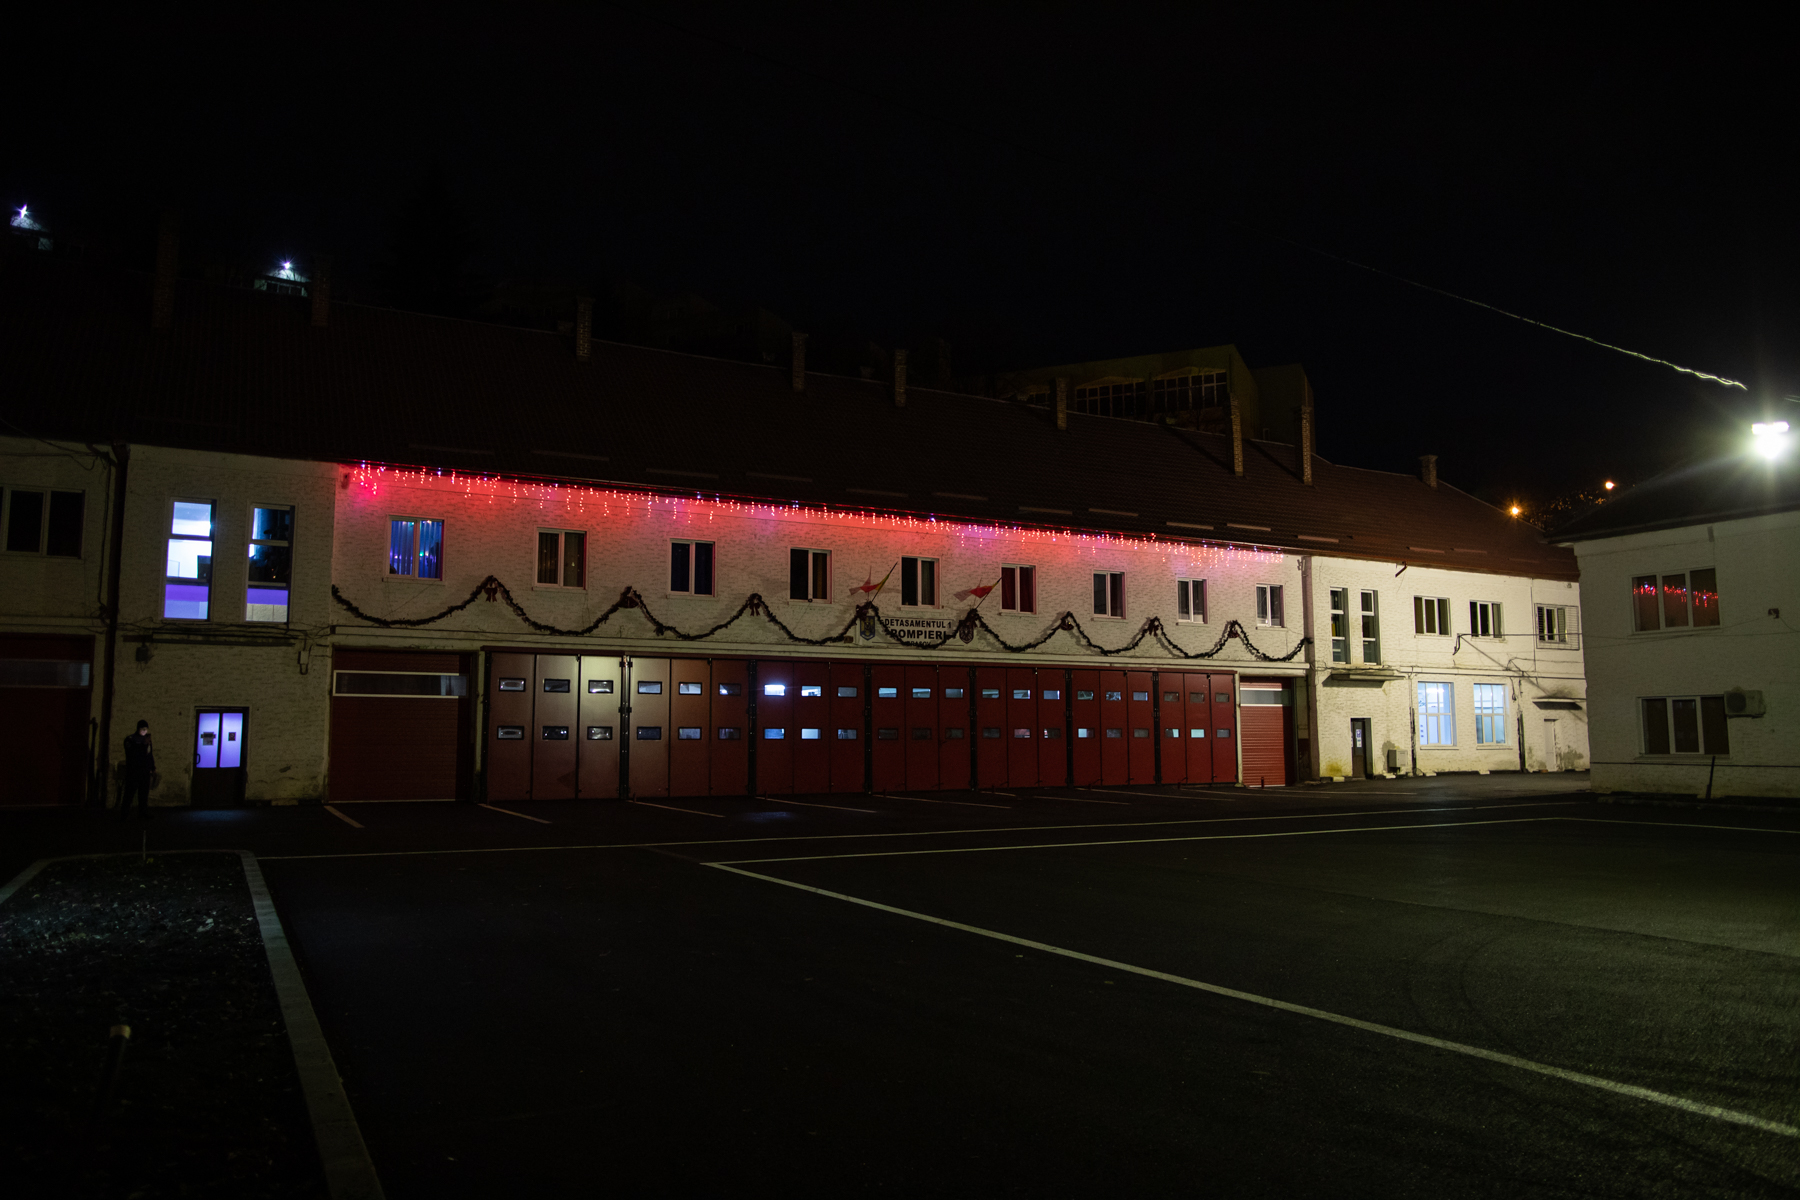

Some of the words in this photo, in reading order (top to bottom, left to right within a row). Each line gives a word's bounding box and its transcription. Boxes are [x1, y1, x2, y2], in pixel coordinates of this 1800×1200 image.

[885, 618, 946, 628] DETASAMENTUL
[947, 621, 952, 629] 1
[890, 629, 946, 640] POMPIERI
